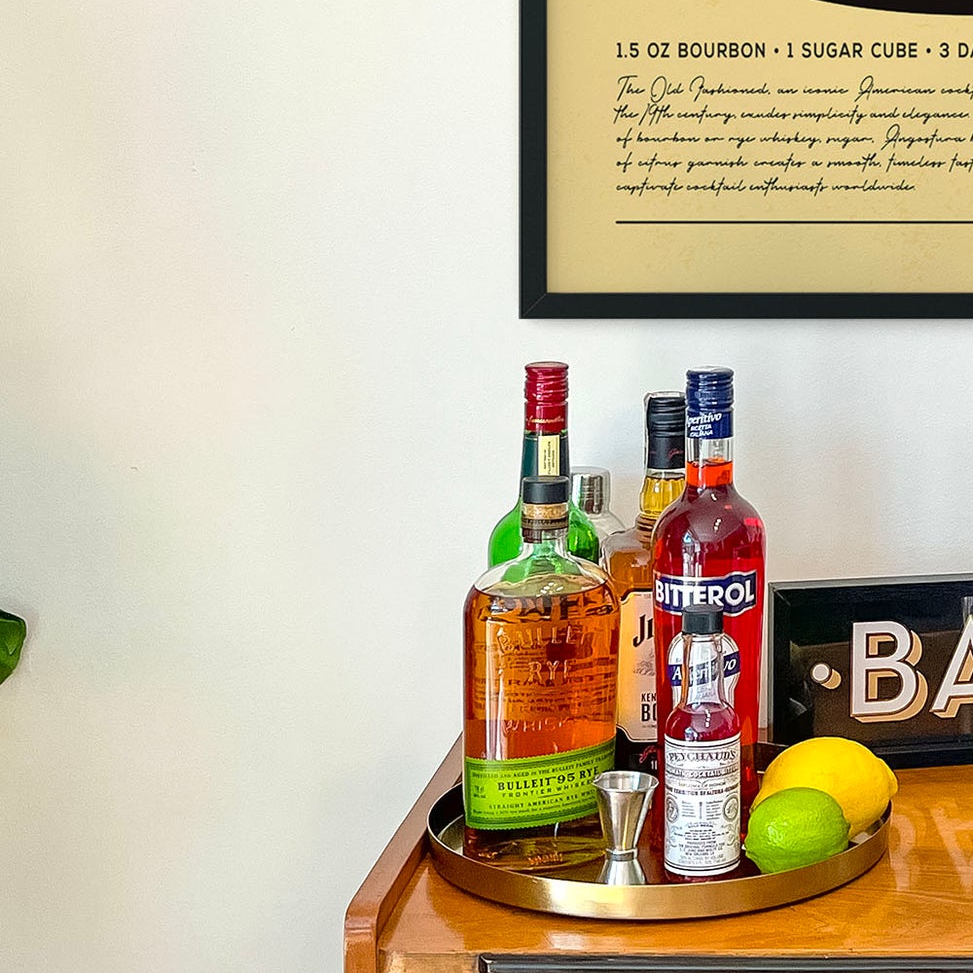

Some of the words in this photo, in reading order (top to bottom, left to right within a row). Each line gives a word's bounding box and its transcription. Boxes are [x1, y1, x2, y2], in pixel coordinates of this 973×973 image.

[616, 42, 639, 58] 1.5
[647, 42, 670, 58] OZ
[678, 42, 766, 58] BOURBON
[787, 42, 794, 58] 1
[801, 42, 863, 58] SUGAR
[871, 42, 918, 58] CUBE
[939, 42, 950, 58] 3
[617, 75, 645, 102] The
[650, 75, 684, 103] Old
[689, 75, 771, 102] Fashioned,
[777, 87, 798, 95] an
[802, 85, 849, 94] iconic
[854, 75, 936, 102] American
[613, 104, 639, 124] the
[638, 102, 674, 126] 19th
[740, 107, 791, 120] exudes
[792, 105, 868, 124] simplicity
[870, 107, 900, 119] and
[616, 127, 633, 149] of
[636, 131, 701, 143] bourbon
[728, 136, 756, 149] rye
[880, 123, 967, 150] Angostura
[616, 152, 633, 173] of
[637, 153, 682, 172] citrus
[687, 156, 749, 173] garnish
[753, 153, 806, 173] creates
[886, 153, 947, 173] timeless
[616, 177, 684, 197] captivate
[686, 177, 747, 197] cocktail
[749, 177, 829, 197] enthusiasts
[686, 412, 723, 428] peritivo
[655, 579, 755, 608] BITTEROL
[556, 773, 576, 785] 95
[579, 766, 599, 780] RYE
[556, 779, 595, 792] WHISKE
